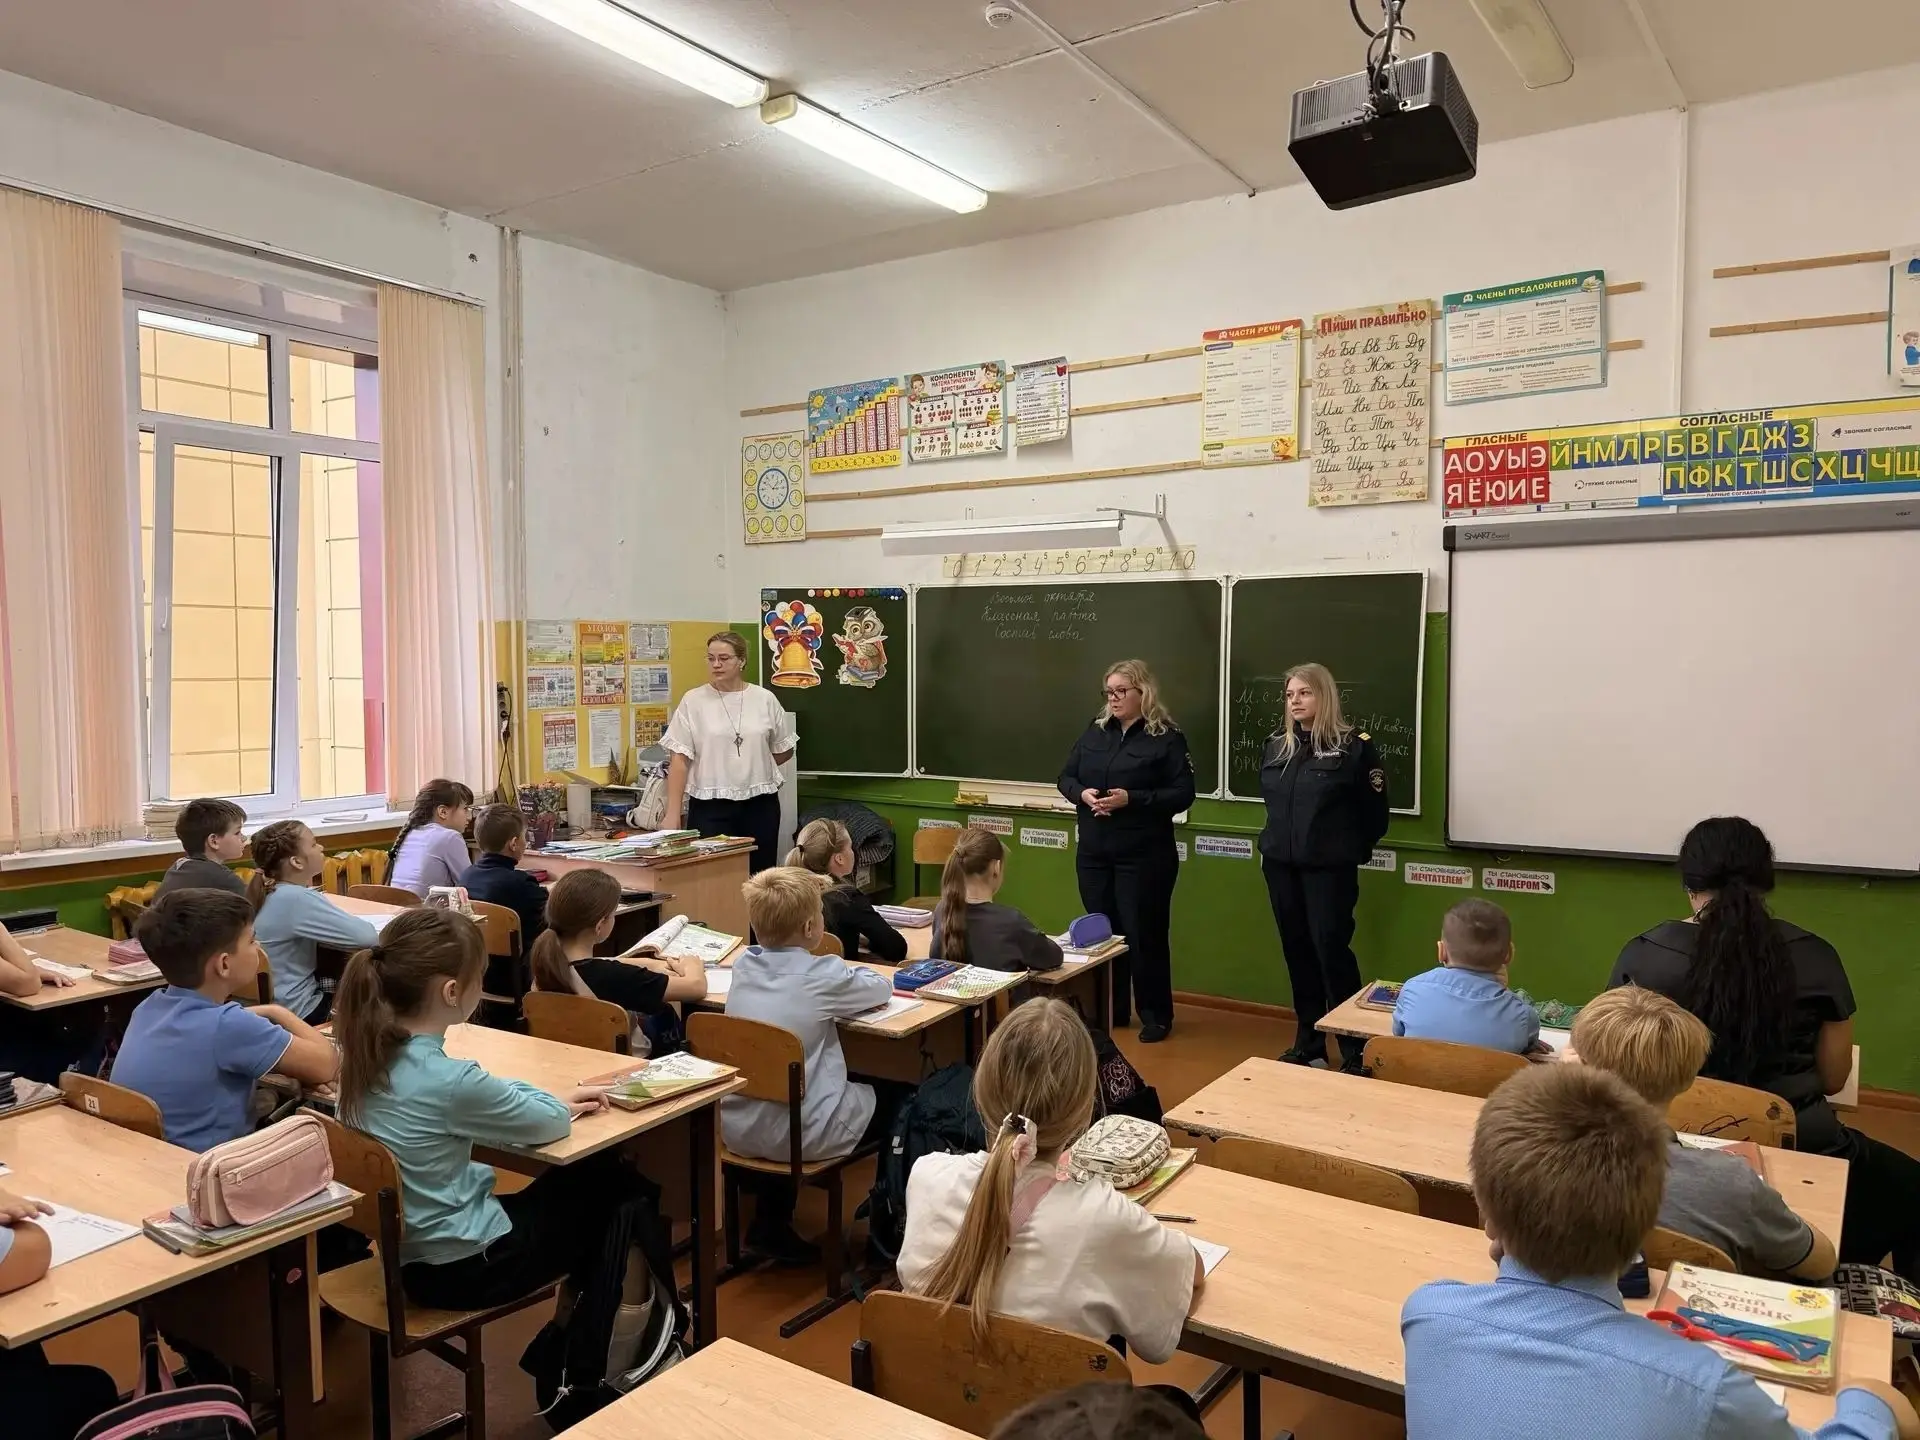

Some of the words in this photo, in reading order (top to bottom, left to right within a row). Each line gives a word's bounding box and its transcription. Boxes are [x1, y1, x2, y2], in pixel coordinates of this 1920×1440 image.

[1476, 290, 1506, 301] ЧЛЕНЫ
[1508, 277, 1578, 296] ПРЕДЛОЖЕНИЯ
[1228, 328, 1256, 338] ЧАСТИ
[1257, 324, 1281, 334] РЕЧИ
[930, 370, 977, 382] КОМПОНЕНТЫ
[1680, 410, 1774, 428] СОГЛАСНЫЕ
[1465, 432, 1528, 447] ГЛАСНЫЕ
[1464, 532, 1491, 541] SMART
[992, 558, 1002, 577] 2
[1012, 557, 1022, 577] 3
[1034, 557, 1043, 576] 4
[1054, 555, 1064, 575] 5
[1075, 555, 1086, 575] 6
[1120, 553, 1132, 573] 8
[1144, 552, 1155, 572] 9
[981, 605, 1041, 622] Классная
[1030, 836, 1058, 846] ТВОРЦОМ
[1411, 872, 1463, 885] МЕЧТАТЕЛЕМ
[1496, 878, 1540, 890] ЛИДЕРОМ
